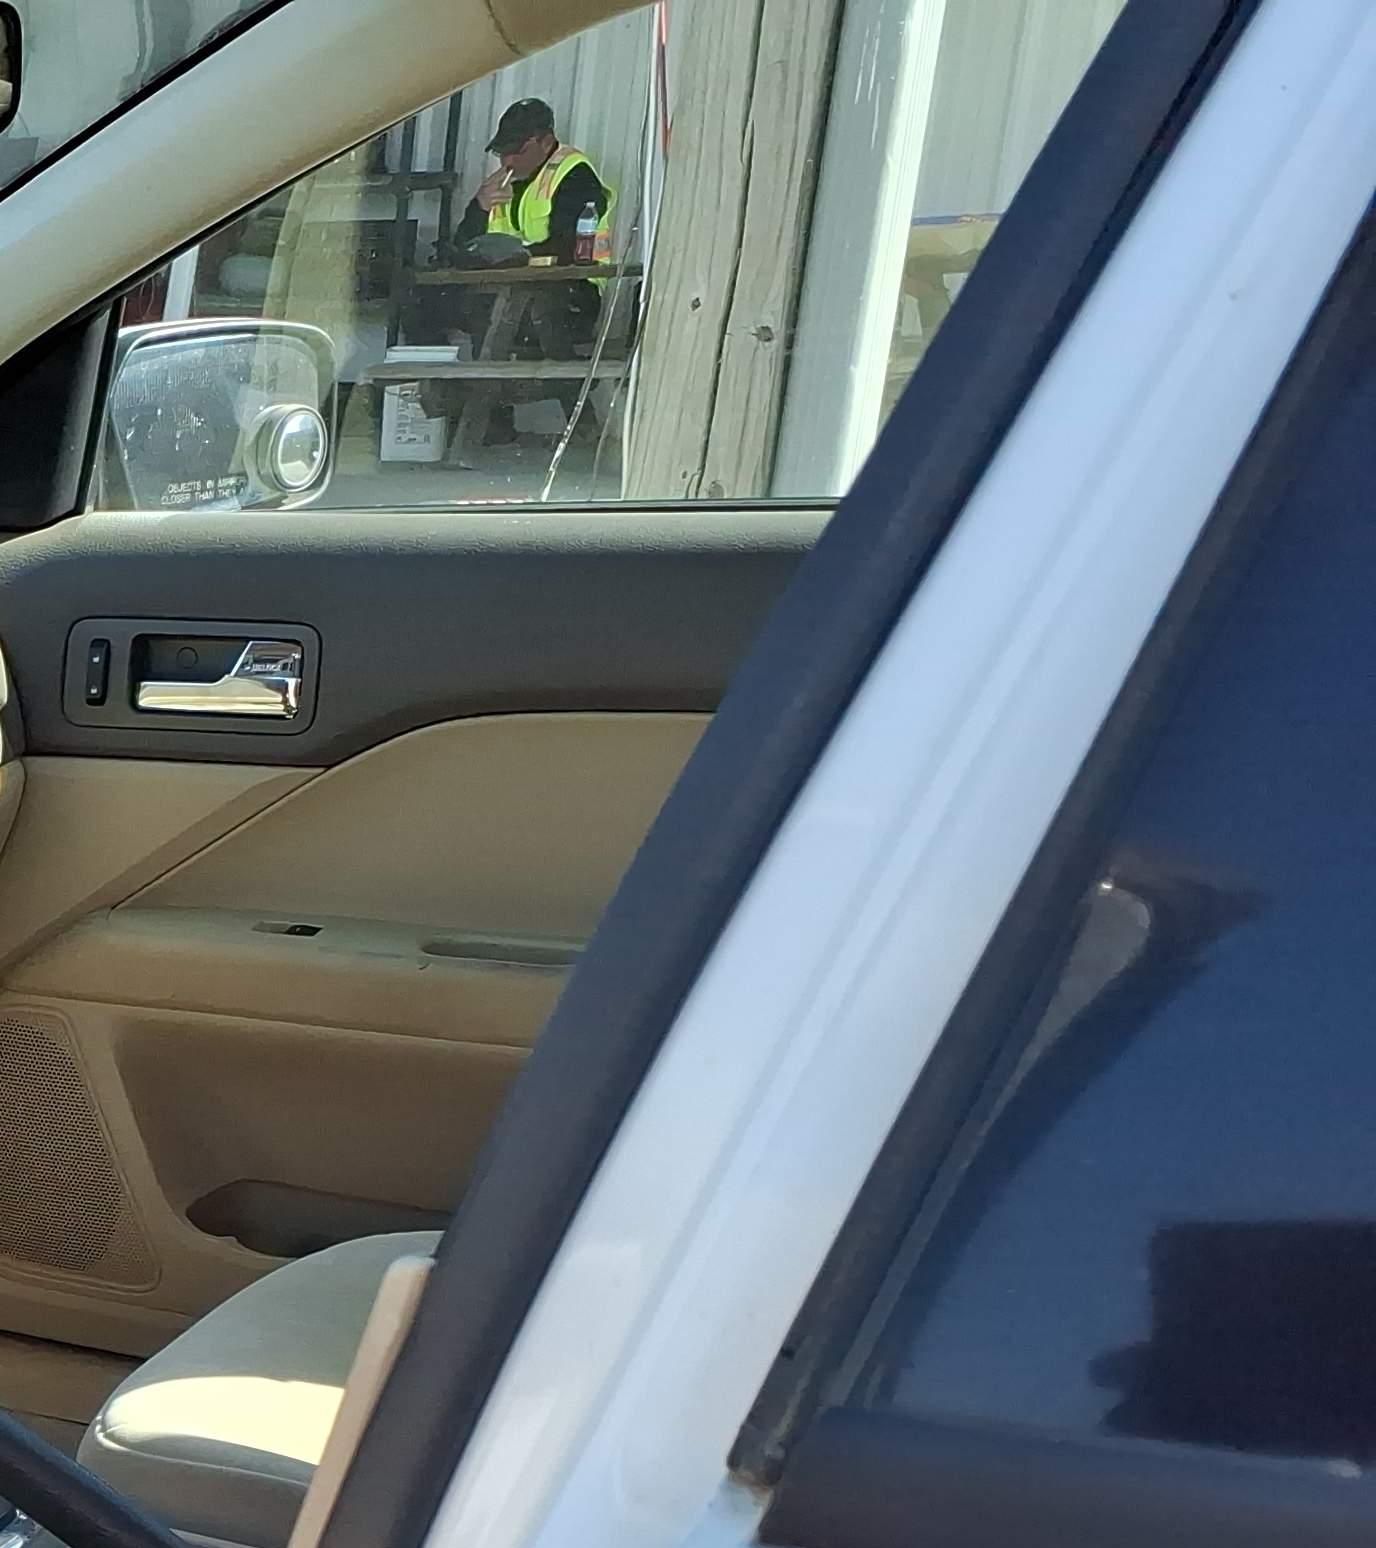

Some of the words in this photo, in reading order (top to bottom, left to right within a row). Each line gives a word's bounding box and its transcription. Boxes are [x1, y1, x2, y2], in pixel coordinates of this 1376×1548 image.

[168, 481, 201, 493] OBJECTS
[161, 493, 191, 505] CLOSER
[195, 490, 215, 501] THAN
